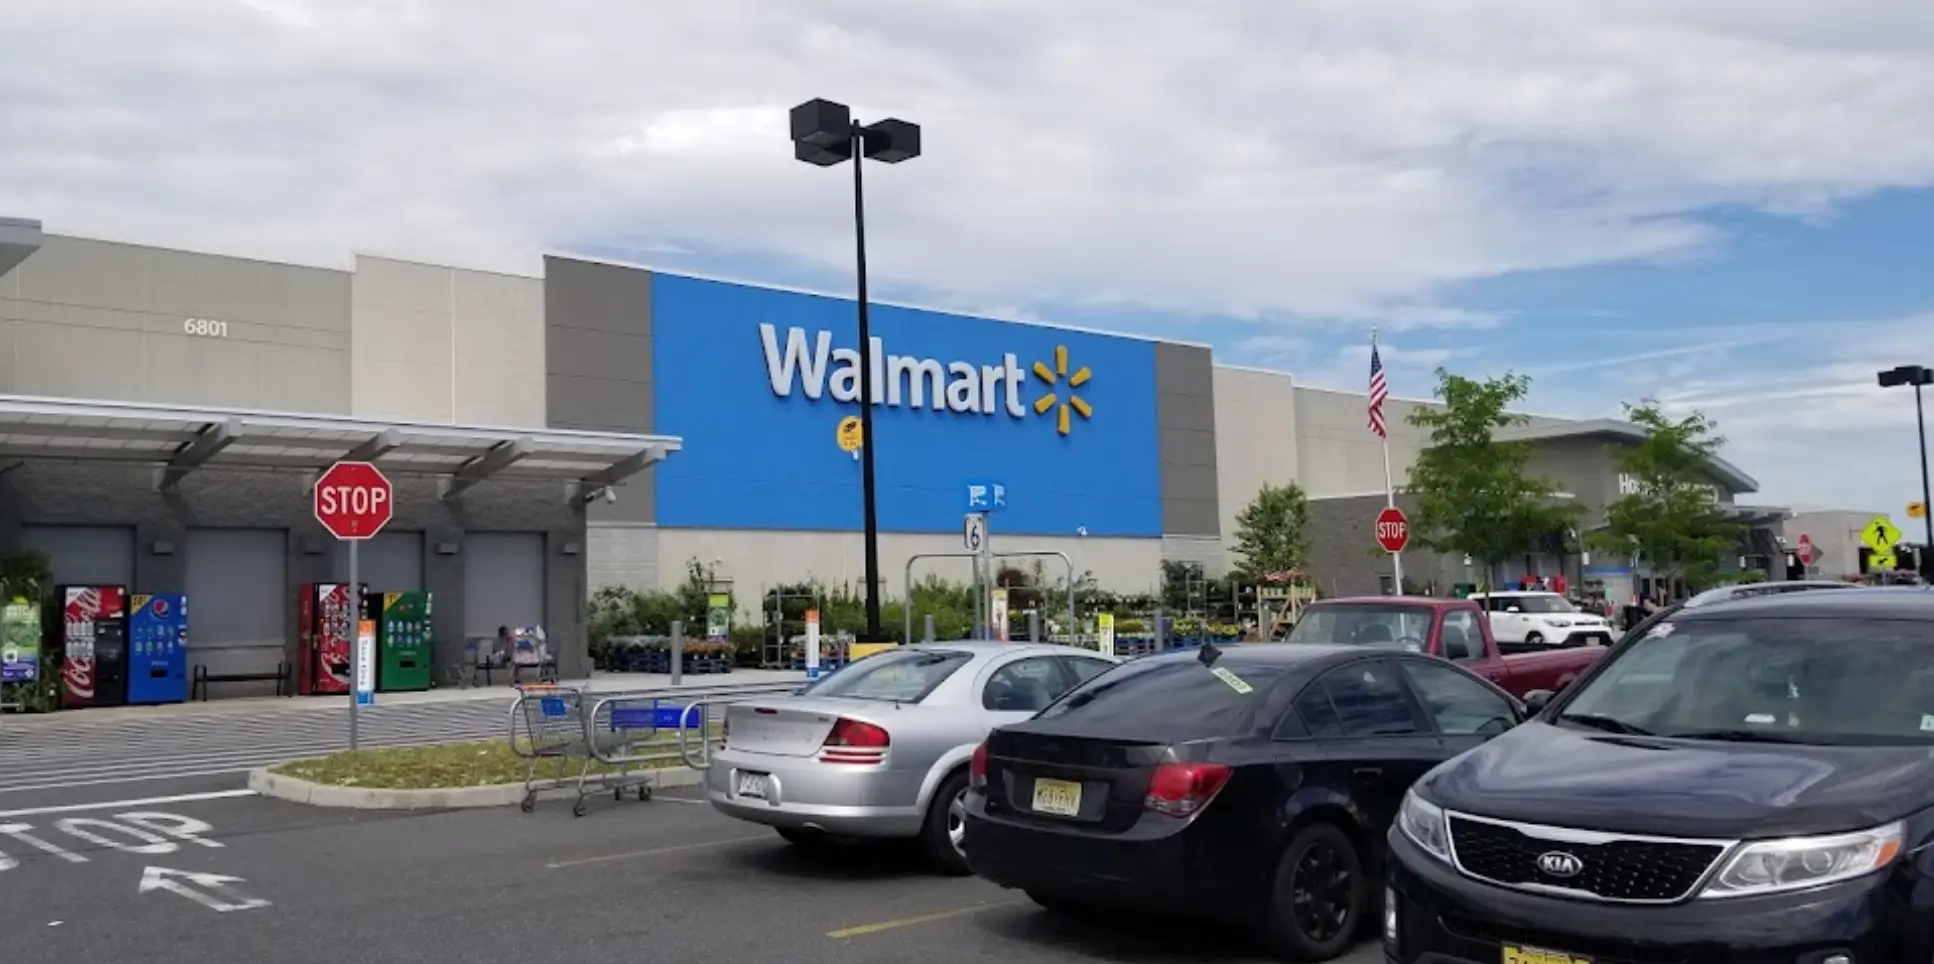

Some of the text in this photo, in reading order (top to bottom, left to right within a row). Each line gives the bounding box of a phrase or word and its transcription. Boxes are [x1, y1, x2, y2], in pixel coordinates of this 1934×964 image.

[184, 318, 227, 337] 6801
[758, 322, 1026, 417] Walmart
[321, 486, 386, 515] STOP
[971, 523, 981, 551] 6
[1379, 521, 1405, 539] STOP
[0, 811, 226, 871] TOP
[1543, 855, 1574, 873] KIA
